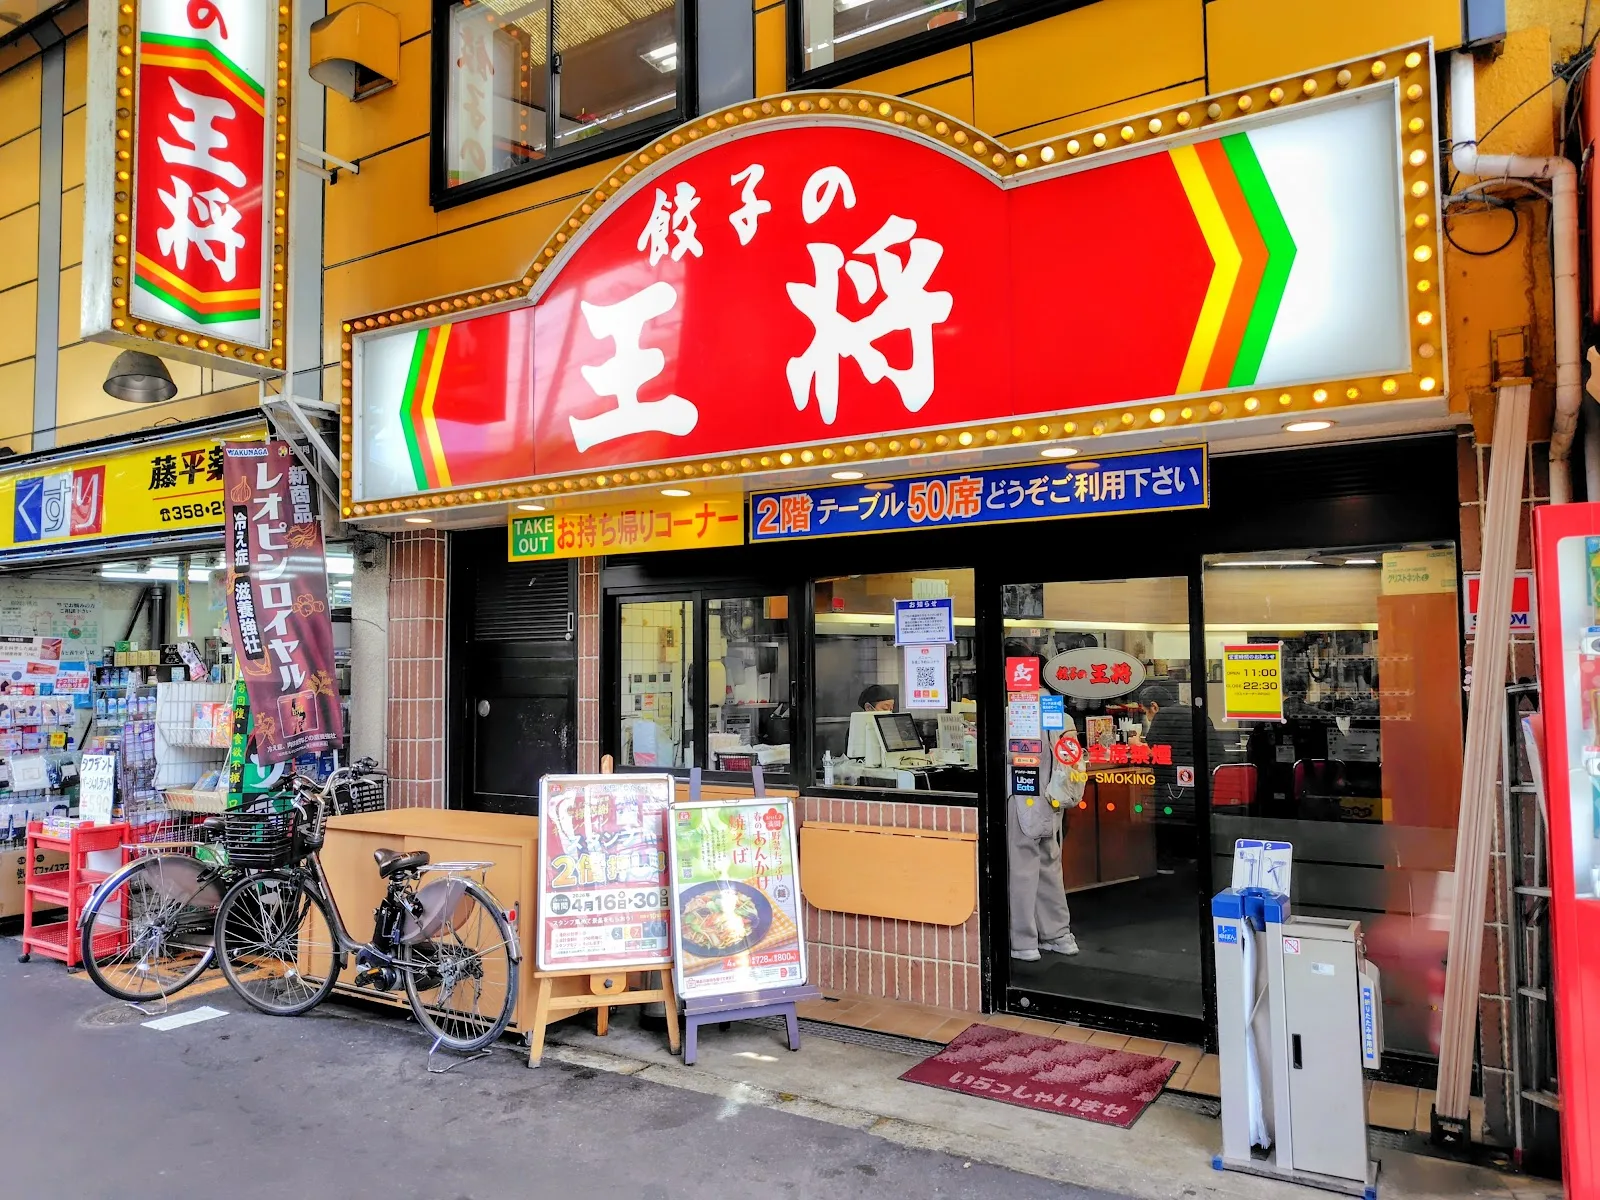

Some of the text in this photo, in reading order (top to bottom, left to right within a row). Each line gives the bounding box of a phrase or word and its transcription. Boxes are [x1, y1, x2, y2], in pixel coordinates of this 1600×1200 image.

[156, 76, 247, 283] 王将
[637, 163, 857, 267] 餃子の
[568, 214, 953, 453] 王将
[226, 448, 268, 457] WAKUNAGA
[17, 474, 98, 534] くすり
[288, 465, 314, 524] 新商品
[756, 463, 1200, 534] 2階 テーブル 50席 どうぞご利用下さい
[233, 511, 249, 567] 冷え症
[514, 520, 554, 535] TAKE
[518, 536, 549, 553] OUT
[557, 503, 739, 550] お持ち帰りコーナー
[252, 462, 306, 692] レオピンロイヤル
[235, 582, 262, 654] 滋養強壮
[908, 600, 938, 609] お知らせ
[1056, 662, 1133, 685] 餃子の王将
[1243, 668, 1278, 677] 11:00
[1243, 681, 1278, 690] 22:30
[1086, 743, 1173, 765] 全席禁煙
[1016, 776, 1035, 785] Uber
[1016, 784, 1035, 792] Eats
[1070, 772, 1156, 786] NO SMOKING
[729, 813, 749, 866] 焼そば
[771, 831, 783, 882] 野菜たっぷり
[948, 1071, 1129, 1118] いらっしゃいませ
